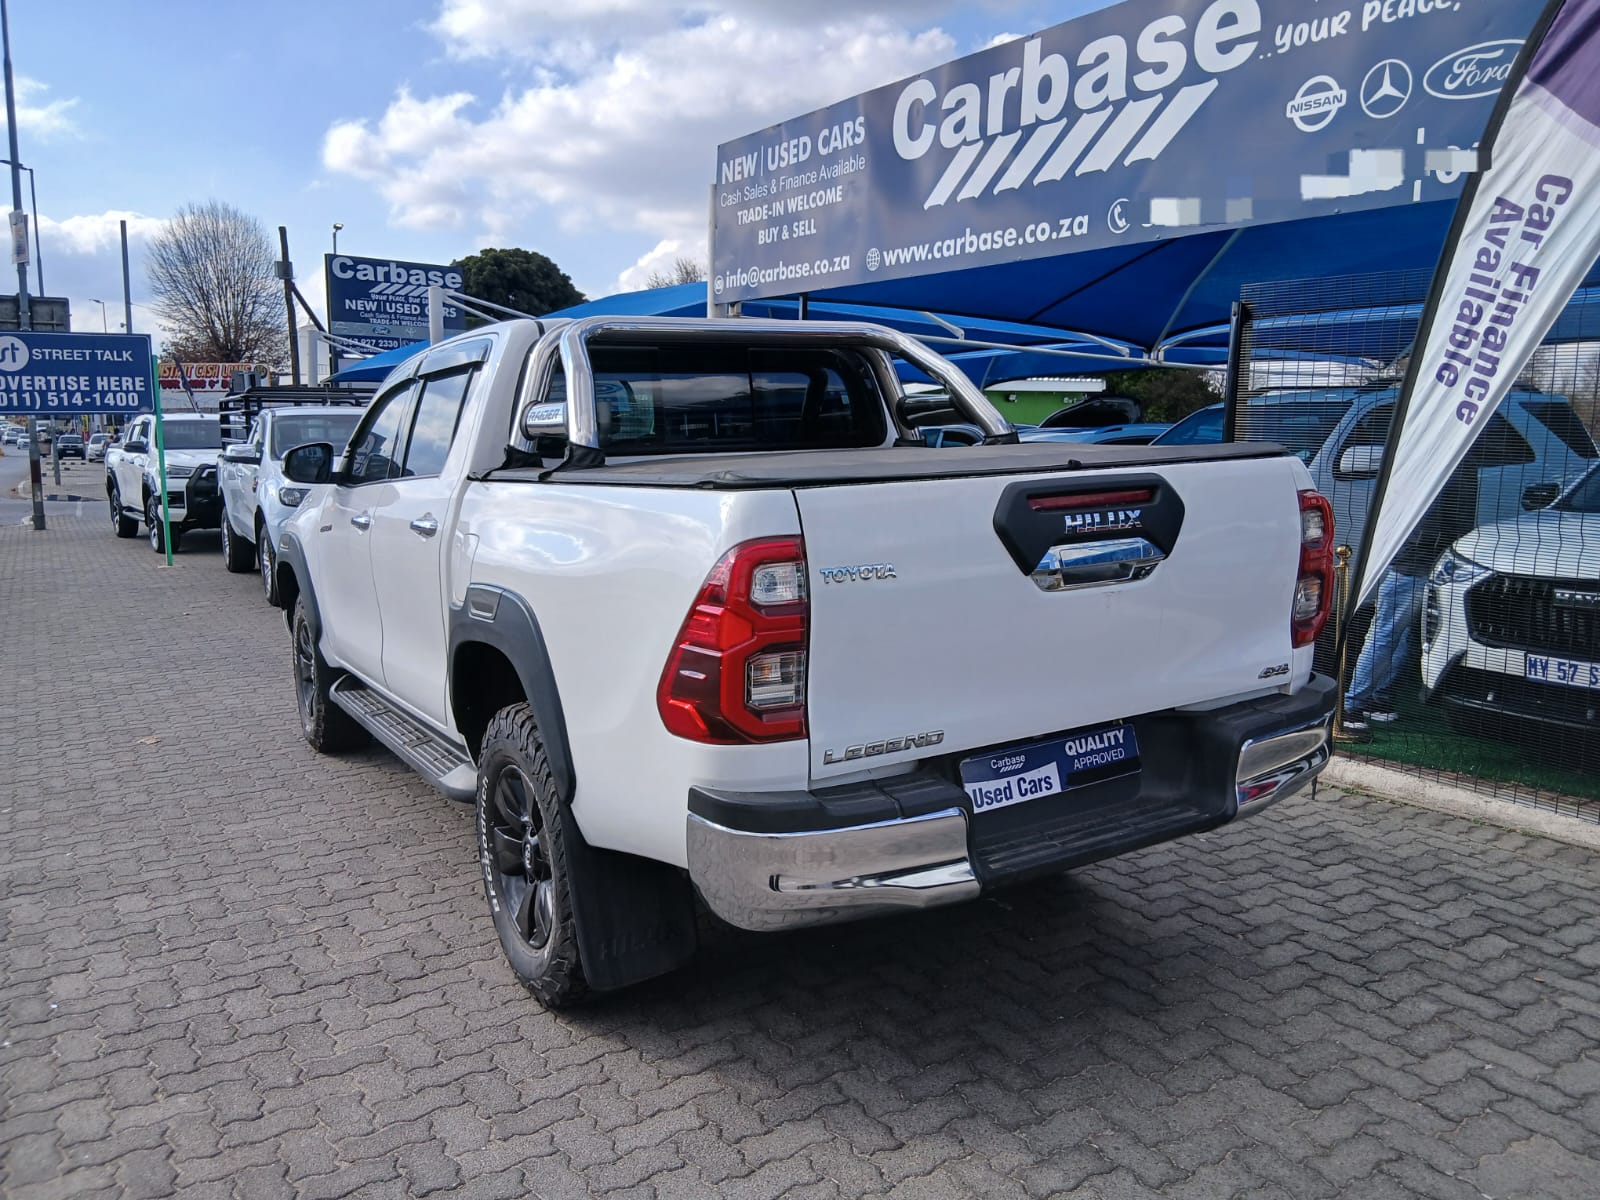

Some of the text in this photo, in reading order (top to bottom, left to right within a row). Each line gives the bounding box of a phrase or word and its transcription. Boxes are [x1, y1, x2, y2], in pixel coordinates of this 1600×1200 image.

[893, 0, 1262, 160] Carbase
[1289, 93, 1344, 115] NISSAN
[721, 115, 866, 185] NEW USED CARS
[720, 153, 866, 208] Cash Sales & Finance Available
[737, 185, 843, 226] TRADE-IN WELCOME
[758, 218, 817, 246] BUY & SELL
[883, 214, 1089, 267] www.carbase.co.za
[331, 256, 463, 289] Carbase
[725, 255, 850, 289] info@carbase.co.za
[344, 298, 378, 312] NEW
[386, 301, 421, 315] USED
[1435, 196, 1526, 389] Available
[1455, 174, 1574, 427] Car Finance
[369, 318, 430, 328] TRADE-IN WELCOM
[32, 348, 134, 361] STREET TALK
[96, 376, 146, 391] HERE
[196, 364, 220, 378] CASH
[47, 392, 140, 407] 514-1400
[1064, 509, 1143, 535] HILUX
[819, 562, 897, 585] TOYOTA
[823, 729, 945, 766] LEGEND
[1064, 728, 1125, 757] QUALITY
[990, 754, 1026, 770] Carbase
[1073, 748, 1125, 771] APPROVED
[972, 774, 1054, 809] Used Cars
